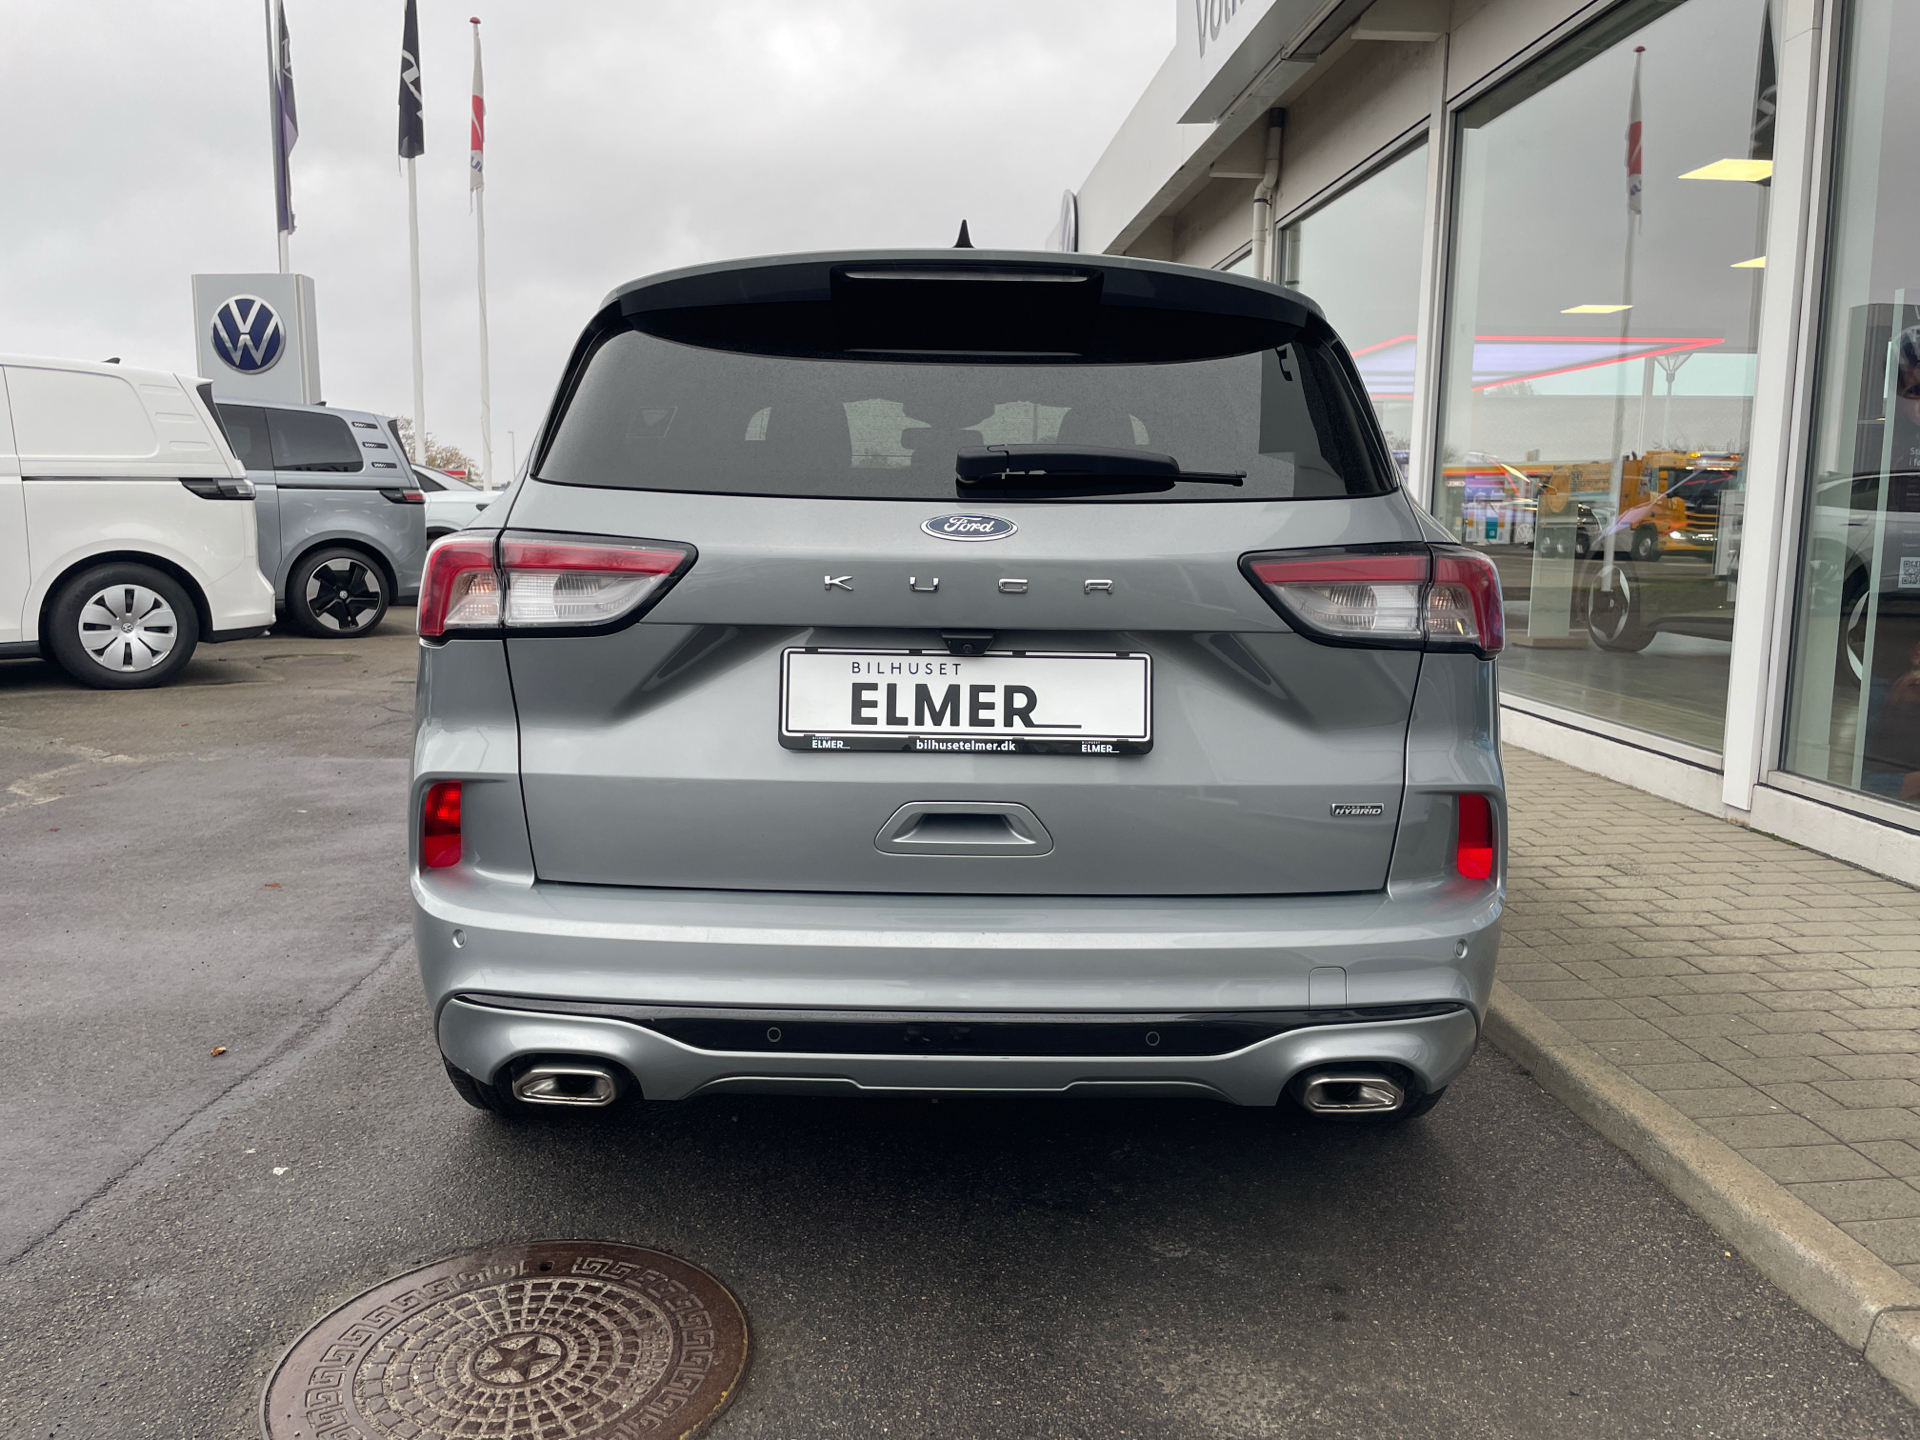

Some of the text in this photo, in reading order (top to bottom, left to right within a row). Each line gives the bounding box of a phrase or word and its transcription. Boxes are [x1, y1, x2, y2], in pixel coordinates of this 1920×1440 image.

[944, 516, 995, 532] Ford
[824, 575, 1113, 594] KUGA
[852, 661, 962, 676] BILHUSET
[851, 682, 1082, 729] ELMER
[812, 739, 850, 749] ELMER
[916, 739, 1016, 751] bilhusetelmer.dk
[1081, 744, 1119, 753] ELMER
